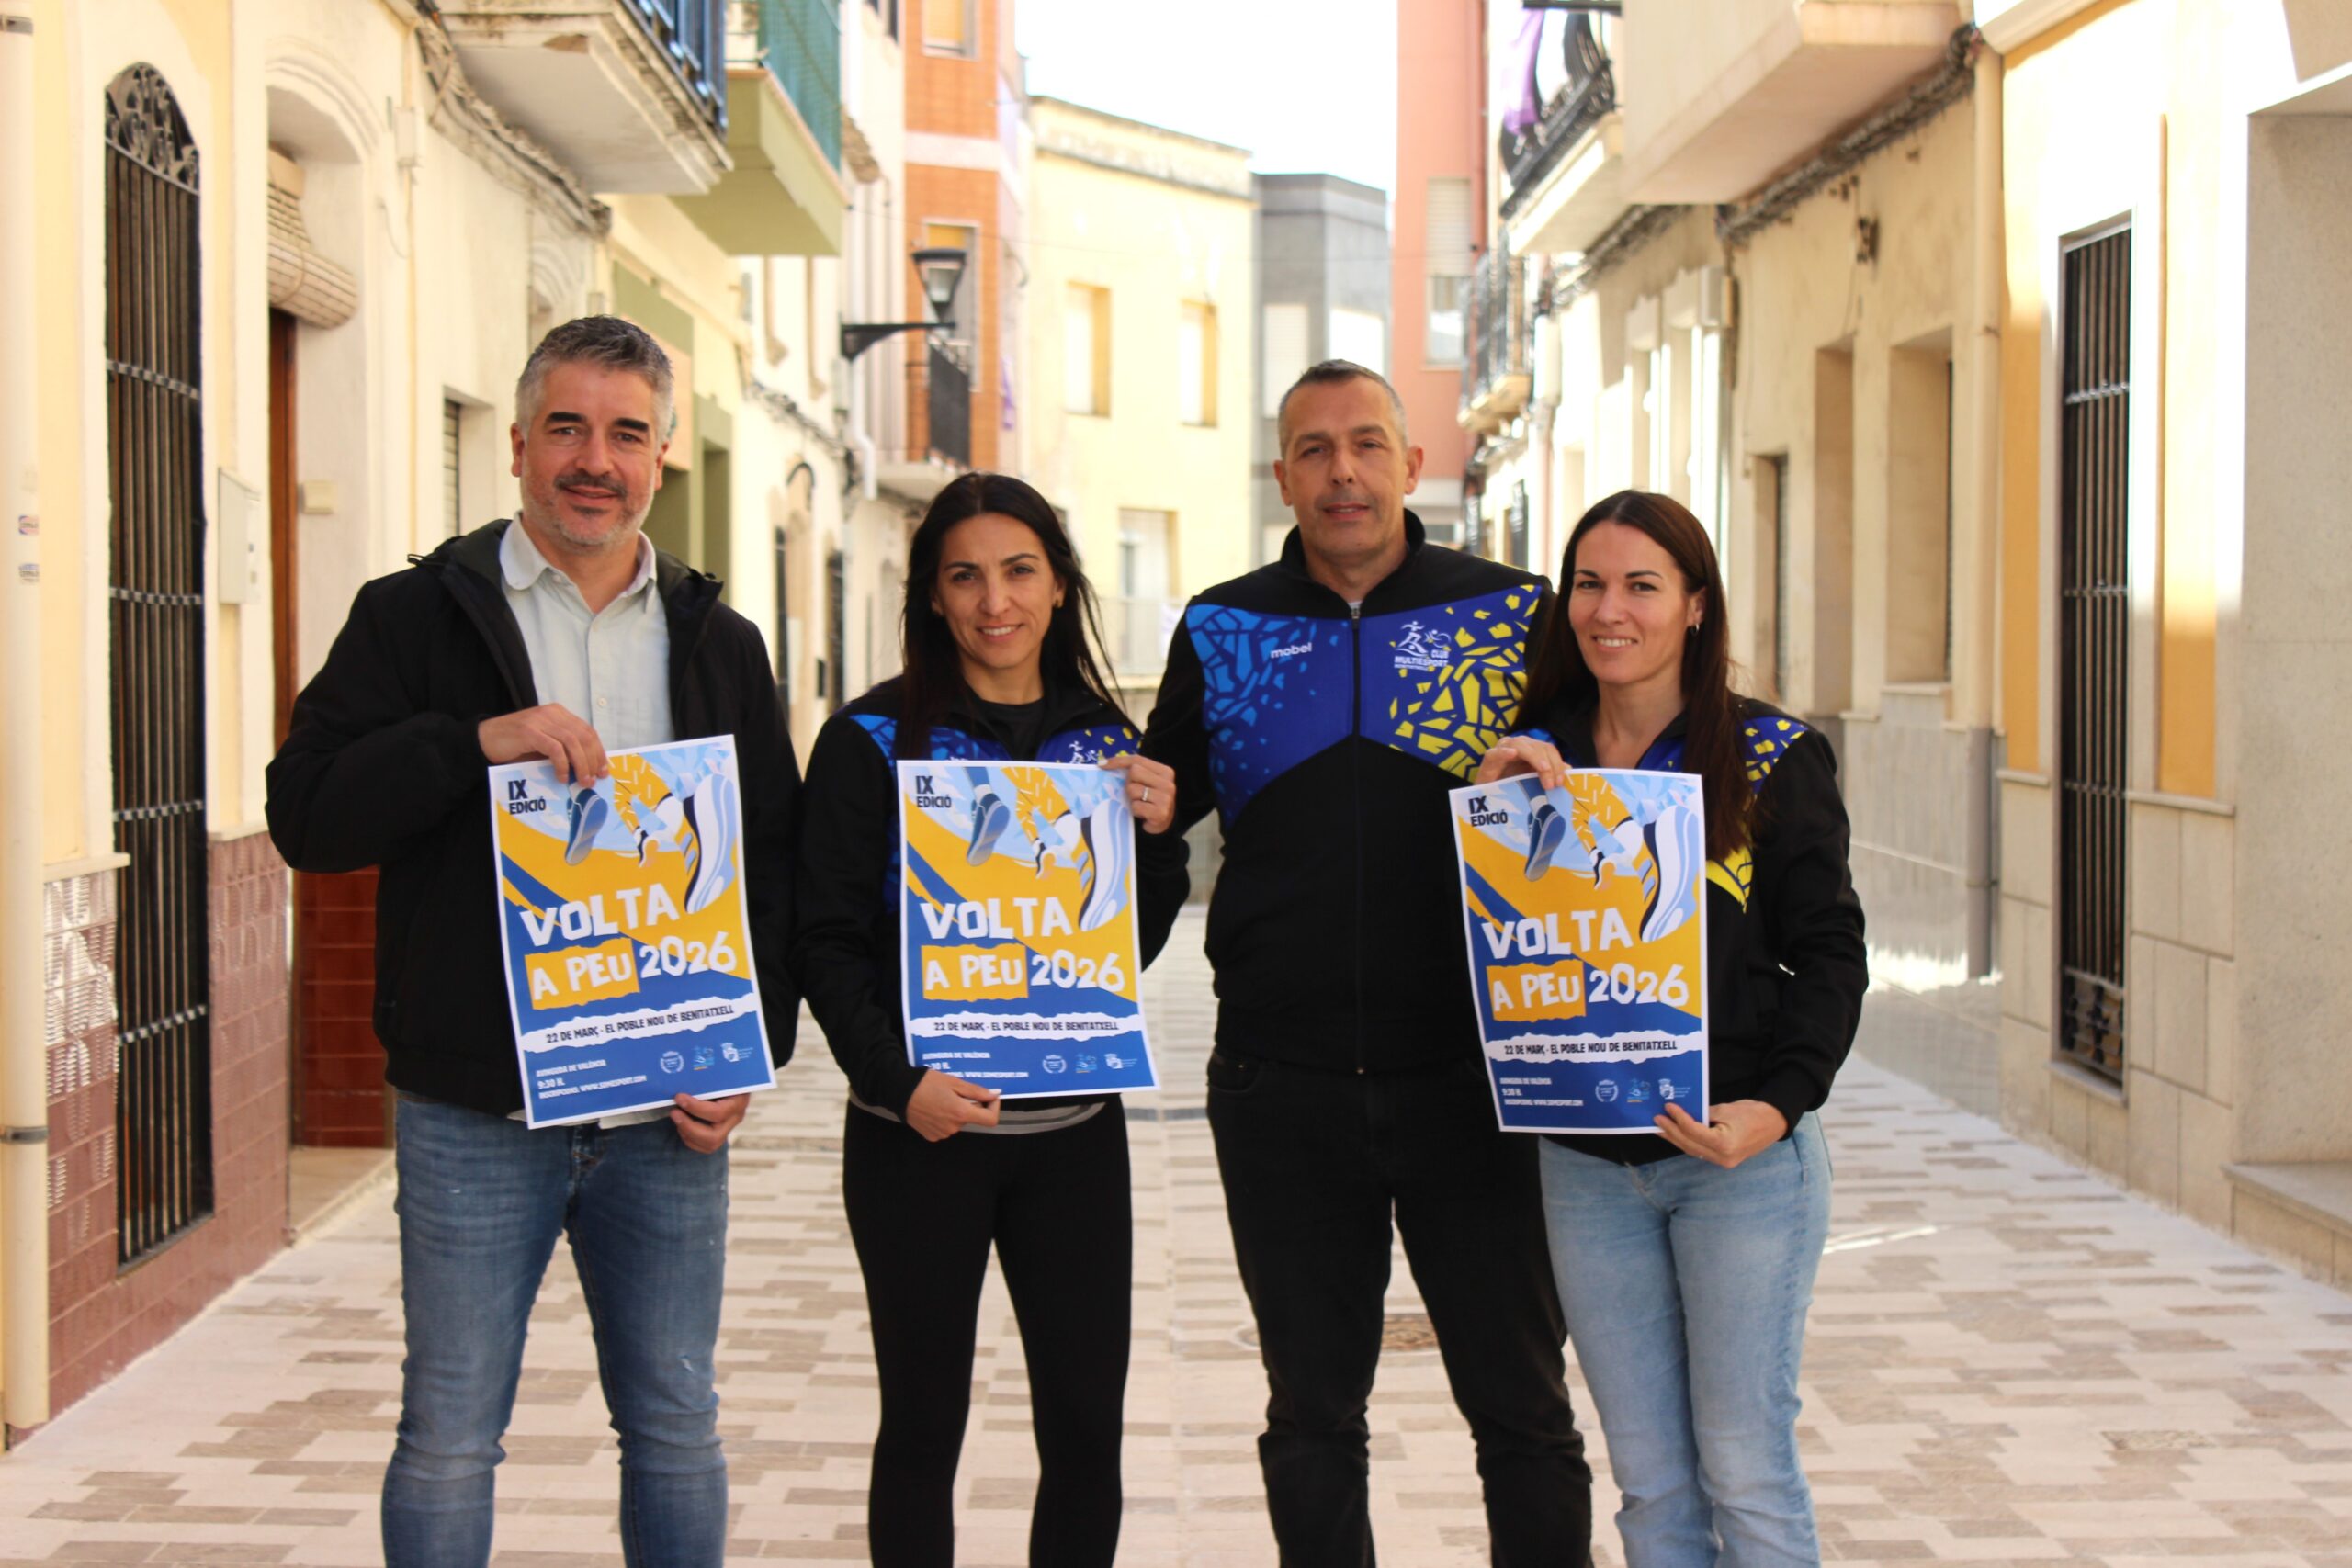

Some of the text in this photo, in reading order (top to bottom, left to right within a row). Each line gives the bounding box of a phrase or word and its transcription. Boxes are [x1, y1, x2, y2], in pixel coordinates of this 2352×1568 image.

[1270, 642, 1312, 659] mobel
[1430, 649, 1449, 659] CLUB
[1394, 656, 1449, 667] MULTIESPORT
[508, 779, 527, 800] IX
[916, 775, 934, 795] IX
[509, 796, 547, 816] EDICIÓ
[916, 795, 952, 808] EDICIÓ
[1469, 795, 1489, 814] IX
[1470, 808, 1508, 827] EDICIÓ
[520, 883, 680, 947] VOLTA
[921, 897, 1073, 940] VOLTA
[1482, 908, 1634, 959] VOLTA
[533, 931, 738, 1001] A PEU 2026
[925, 949, 1125, 992] A PEU 2026
[1492, 963, 1690, 1012] A PEU 2026
[546, 1033, 559, 1043] 22
[560, 1031, 572, 1041] DE
[574, 1028, 599, 1039] MARÇ
[605, 1024, 616, 1034] EL
[617, 1021, 645, 1032] POBLE
[647, 1016, 665, 1027] NOU
[667, 1014, 679, 1023] DE
[681, 1005, 734, 1022] BENITATXELL
[934, 1022, 944, 1031] 22
[948, 1022, 958, 1031] DE
[961, 1022, 985, 1033] MARÇ
[991, 1022, 1001, 1031] EL
[1003, 1022, 1029, 1031] POBLE
[1032, 1022, 1050, 1031] NOU
[1052, 1022, 1063, 1031] DE
[1066, 1021, 1120, 1031] BENITATXELL
[1504, 1045, 1514, 1055] 22
[1515, 1044, 1524, 1054] DE
[1526, 1044, 1545, 1056] MARÇ
[1551, 1044, 1559, 1054] EL
[1560, 1043, 1585, 1054] POBLE
[1588, 1043, 1606, 1053] NOU
[1609, 1042, 1620, 1052] DE
[1623, 1041, 1678, 1052] BENITATXELL
